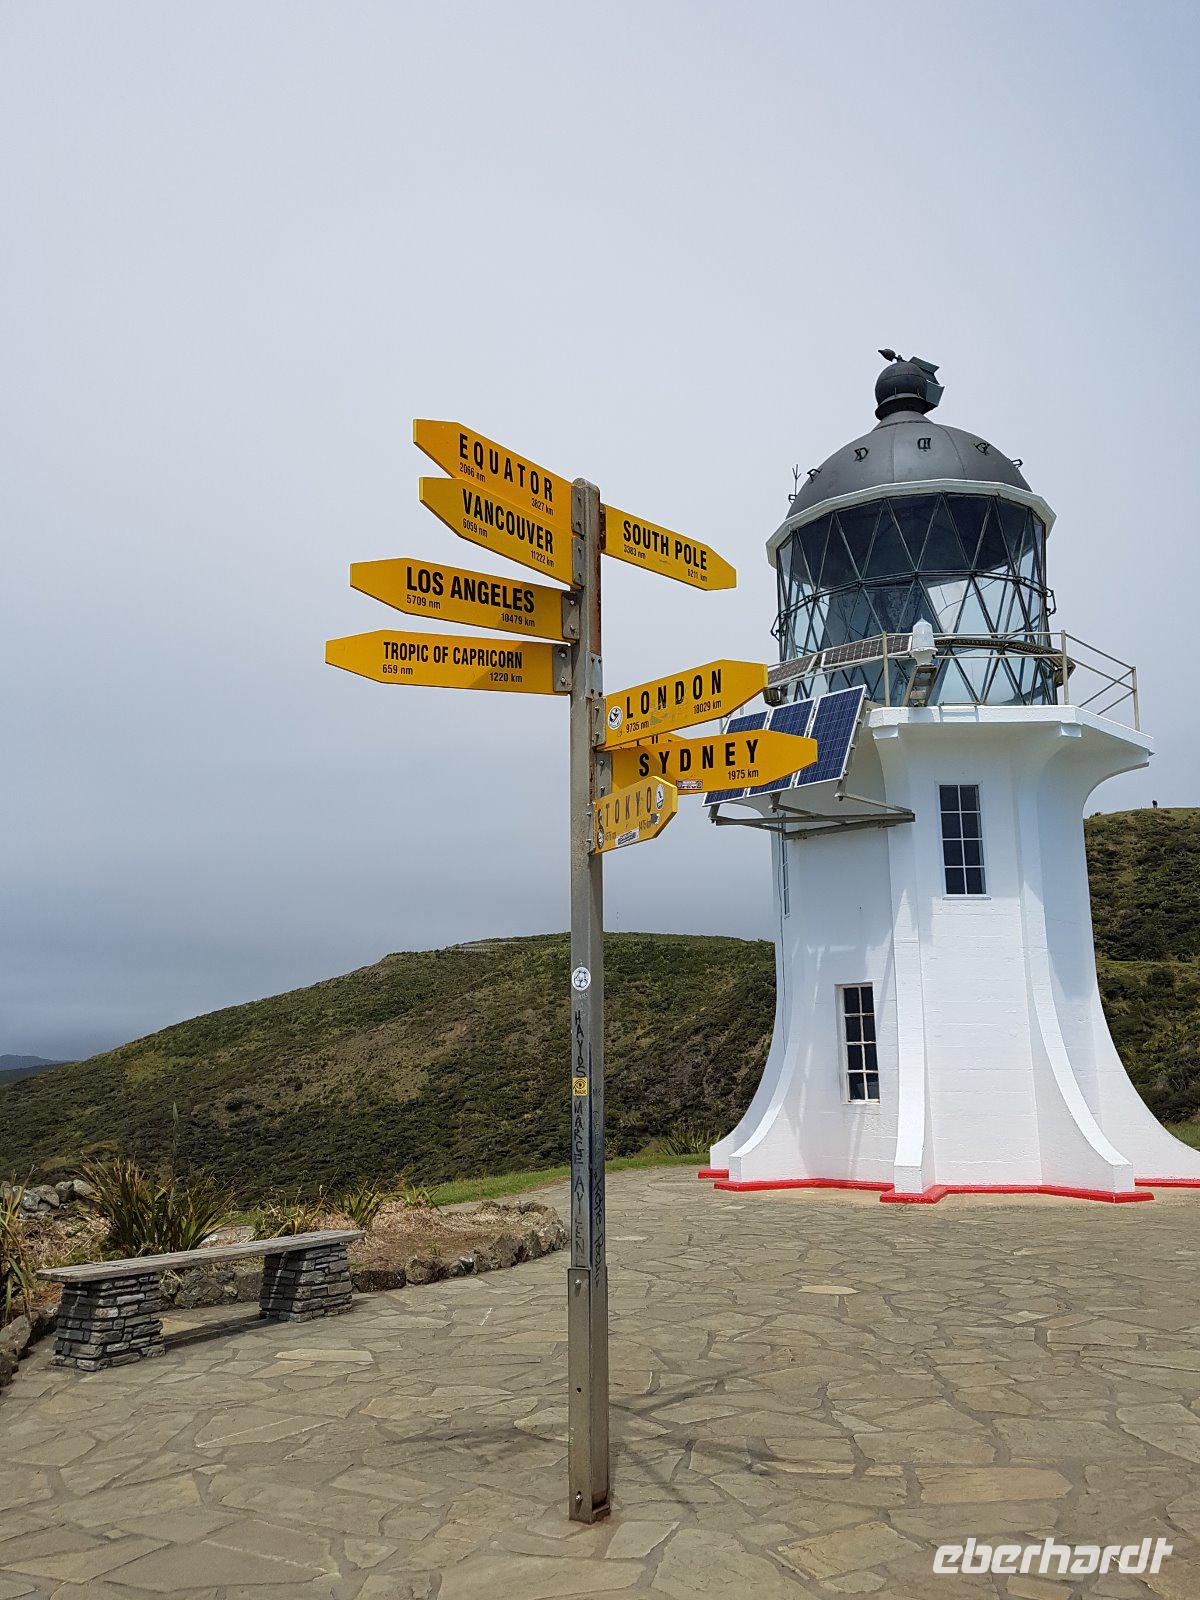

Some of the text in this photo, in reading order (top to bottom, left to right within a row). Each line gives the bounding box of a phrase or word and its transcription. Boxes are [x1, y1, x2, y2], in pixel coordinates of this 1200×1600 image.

[459, 433, 553, 502] EQUATOR
[459, 462, 486, 482] 2066 nm
[531, 498, 554, 516] 3827 km
[462, 488, 553, 554] VANCOUVER
[463, 519, 488, 538] 6059 nm
[623, 520, 707, 570] SOUTH POLE
[547, 558, 555, 568] km
[638, 551, 647, 559] nm
[699, 573, 708, 582] km
[407, 566, 535, 613] LOS ANGELES
[406, 594, 441, 609] 5709 nm
[501, 612, 536, 627] 10479 km
[384, 641, 523, 669] TROPIC OF CAPRICORN
[382, 664, 413, 675] 659 nm
[490, 672, 523, 683] 1220 km
[626, 669, 722, 719] LONDON
[712, 699, 722, 709] km
[626, 720, 650, 733] 9735 nm
[638, 739, 759, 777] SYDNEY
[728, 768, 759, 781] 1975 km
[606, 787, 652, 827] TOKYO
